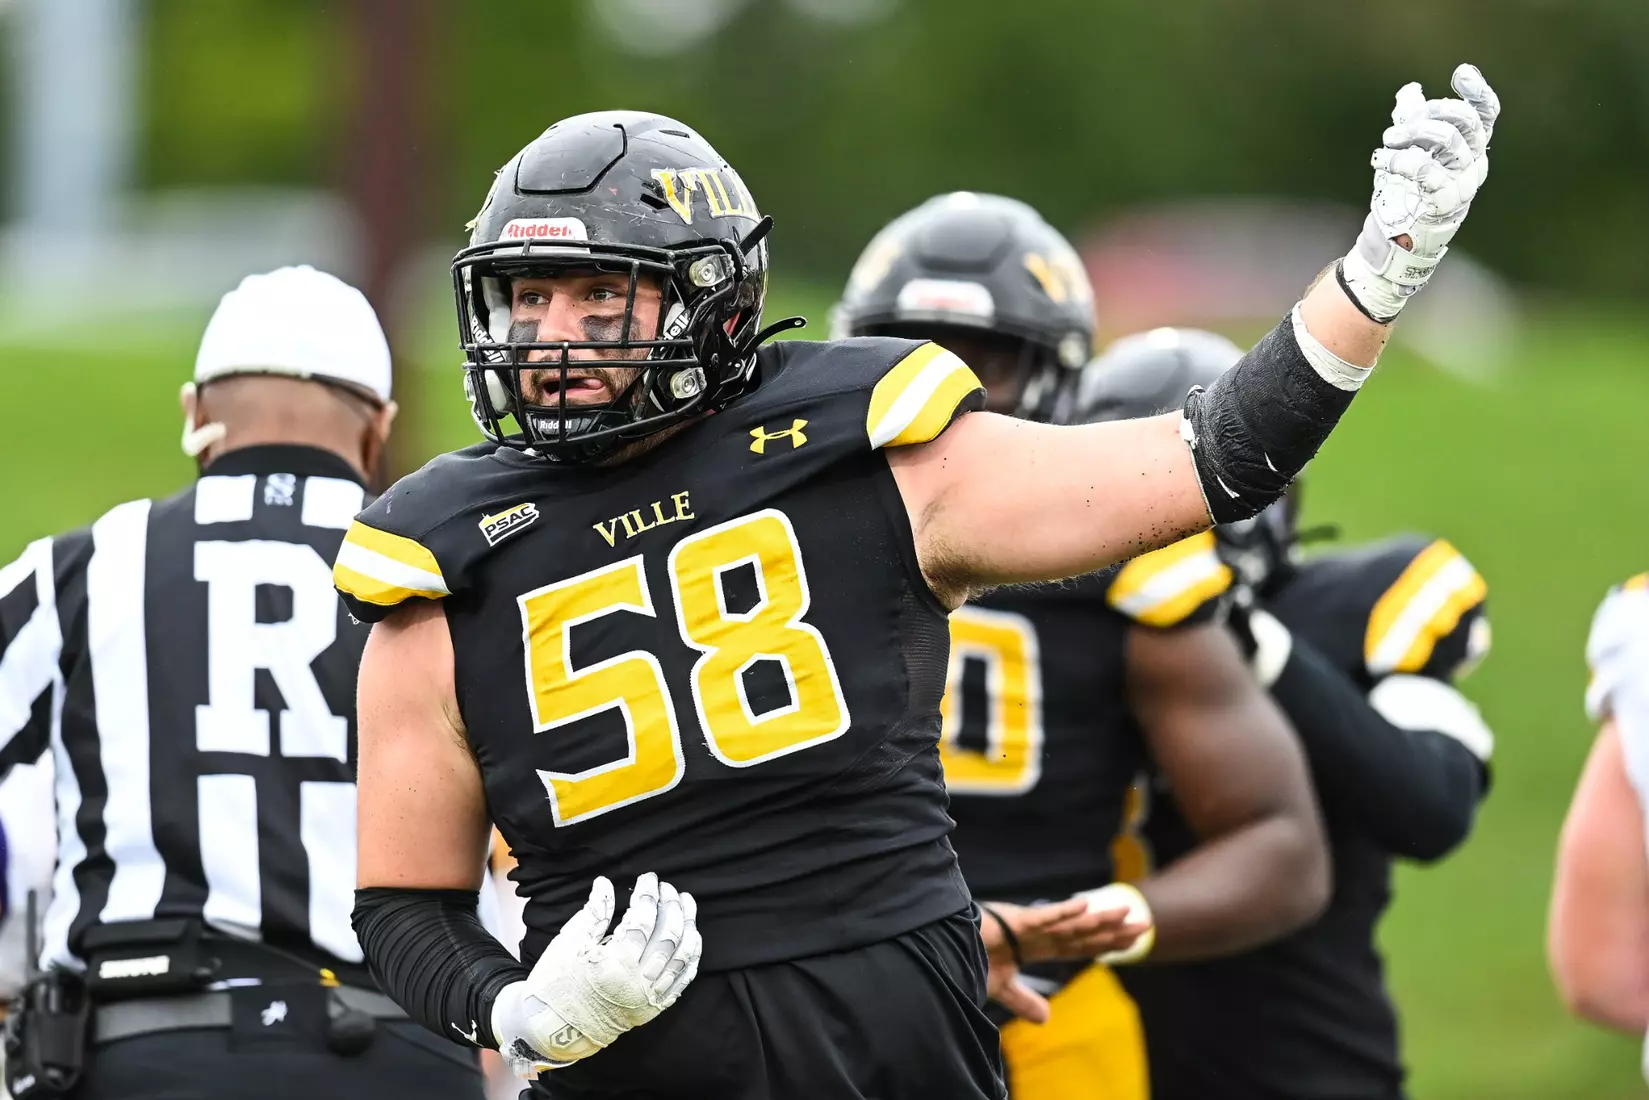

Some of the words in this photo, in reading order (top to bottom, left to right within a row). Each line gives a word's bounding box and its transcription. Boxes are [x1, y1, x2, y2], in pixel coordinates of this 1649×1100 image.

[540, 420, 572, 430] Riddll
[485, 507, 534, 538] PSAC
[593, 491, 695, 548] VILLE
[194, 539, 348, 765] R
[517, 508, 851, 828] 58
